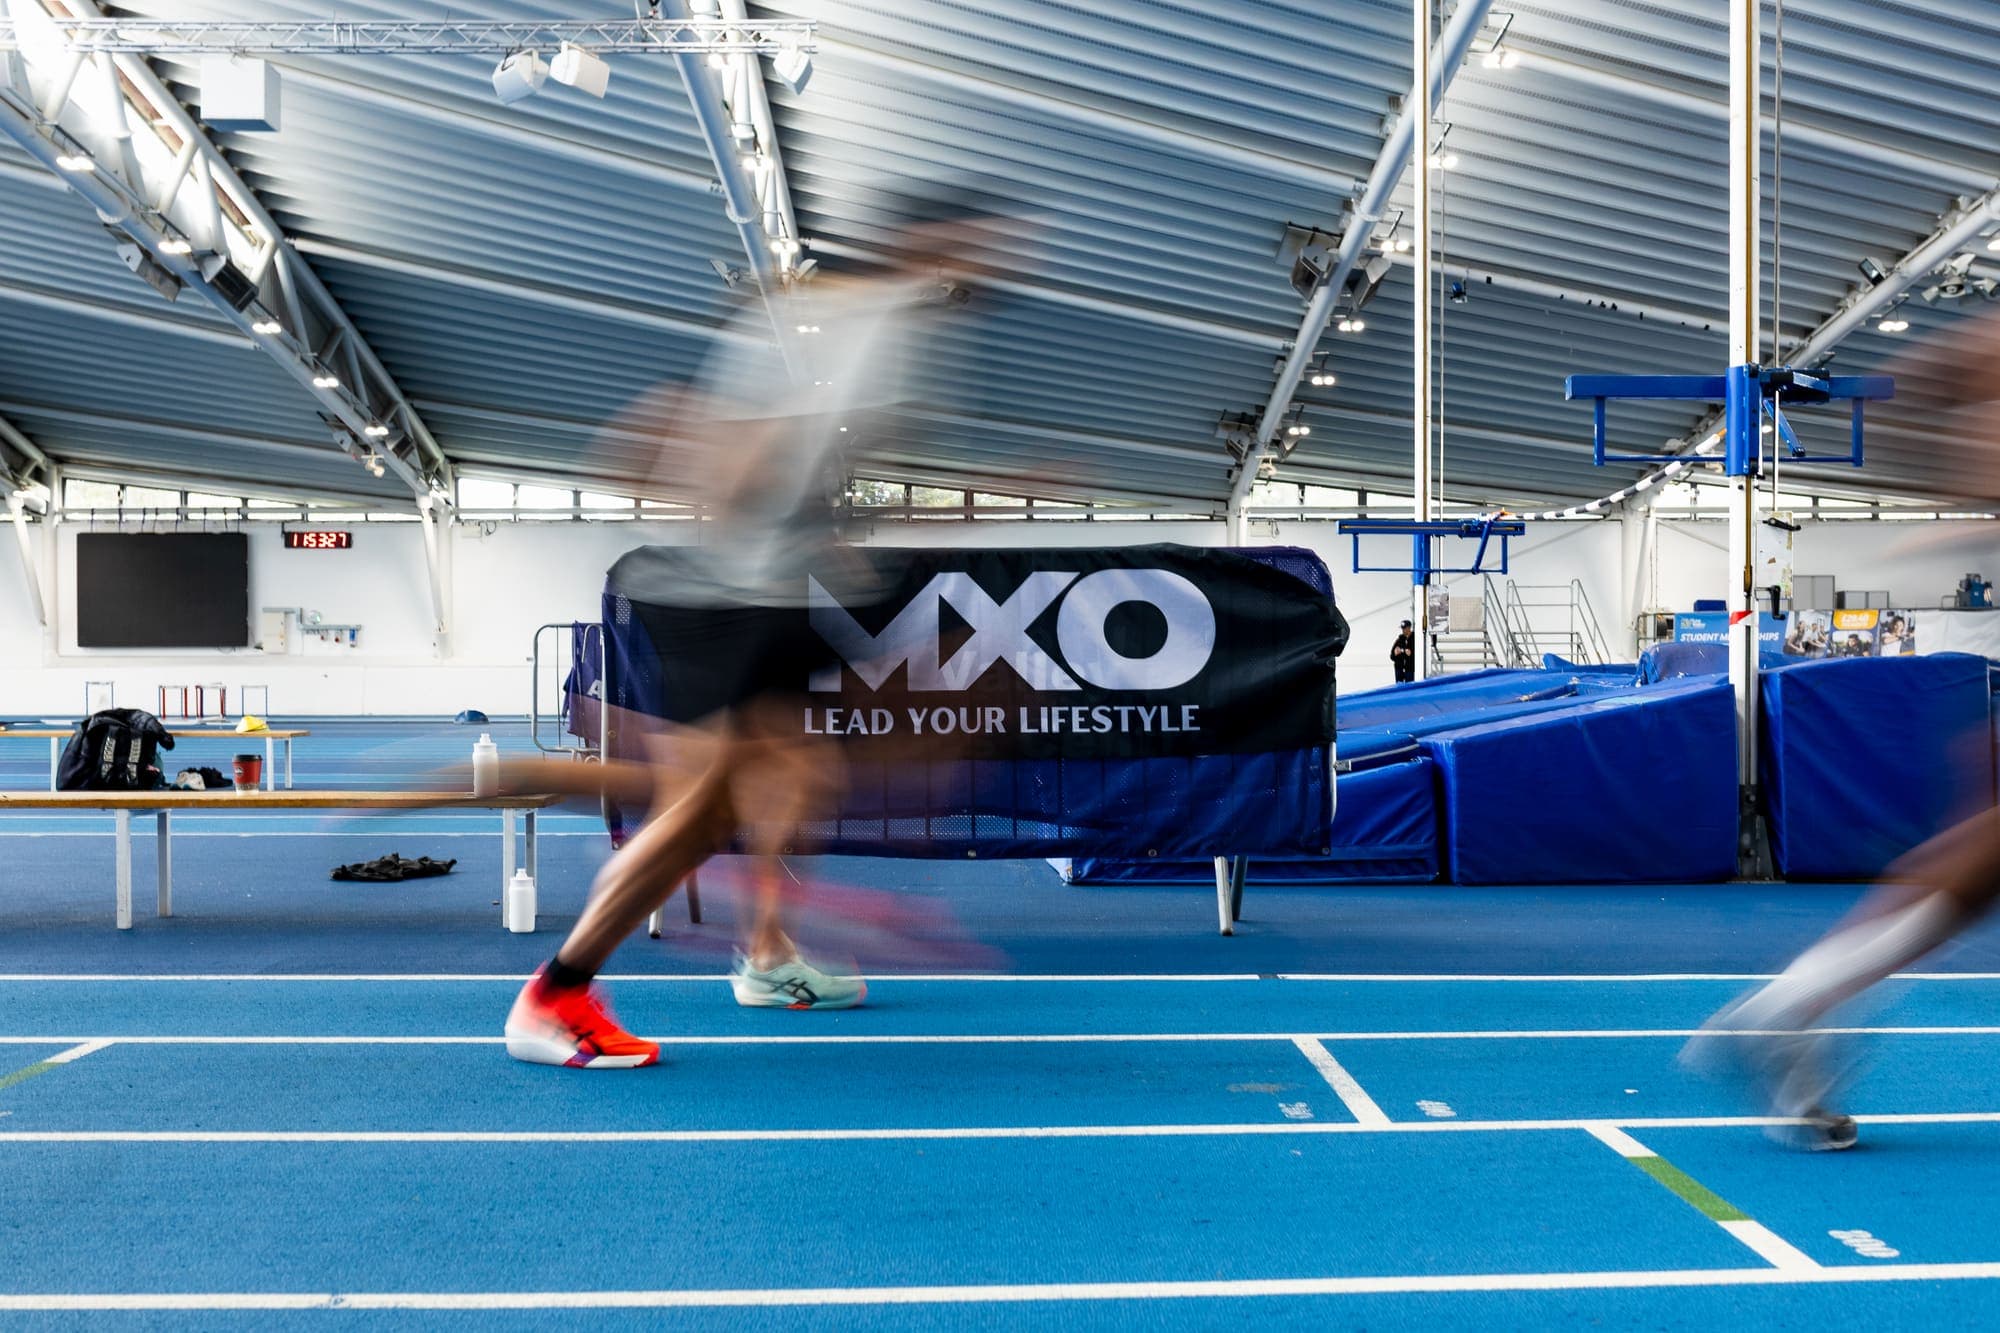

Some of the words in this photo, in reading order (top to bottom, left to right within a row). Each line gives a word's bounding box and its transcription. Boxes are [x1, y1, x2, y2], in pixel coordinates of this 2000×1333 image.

[808, 568, 1216, 693] MXO
[1680, 633, 1718, 642] STUDENT
[804, 707, 894, 734] LEAD
[907, 706, 1006, 734] YOUR
[1019, 704, 1200, 733] LIFESTYLE
